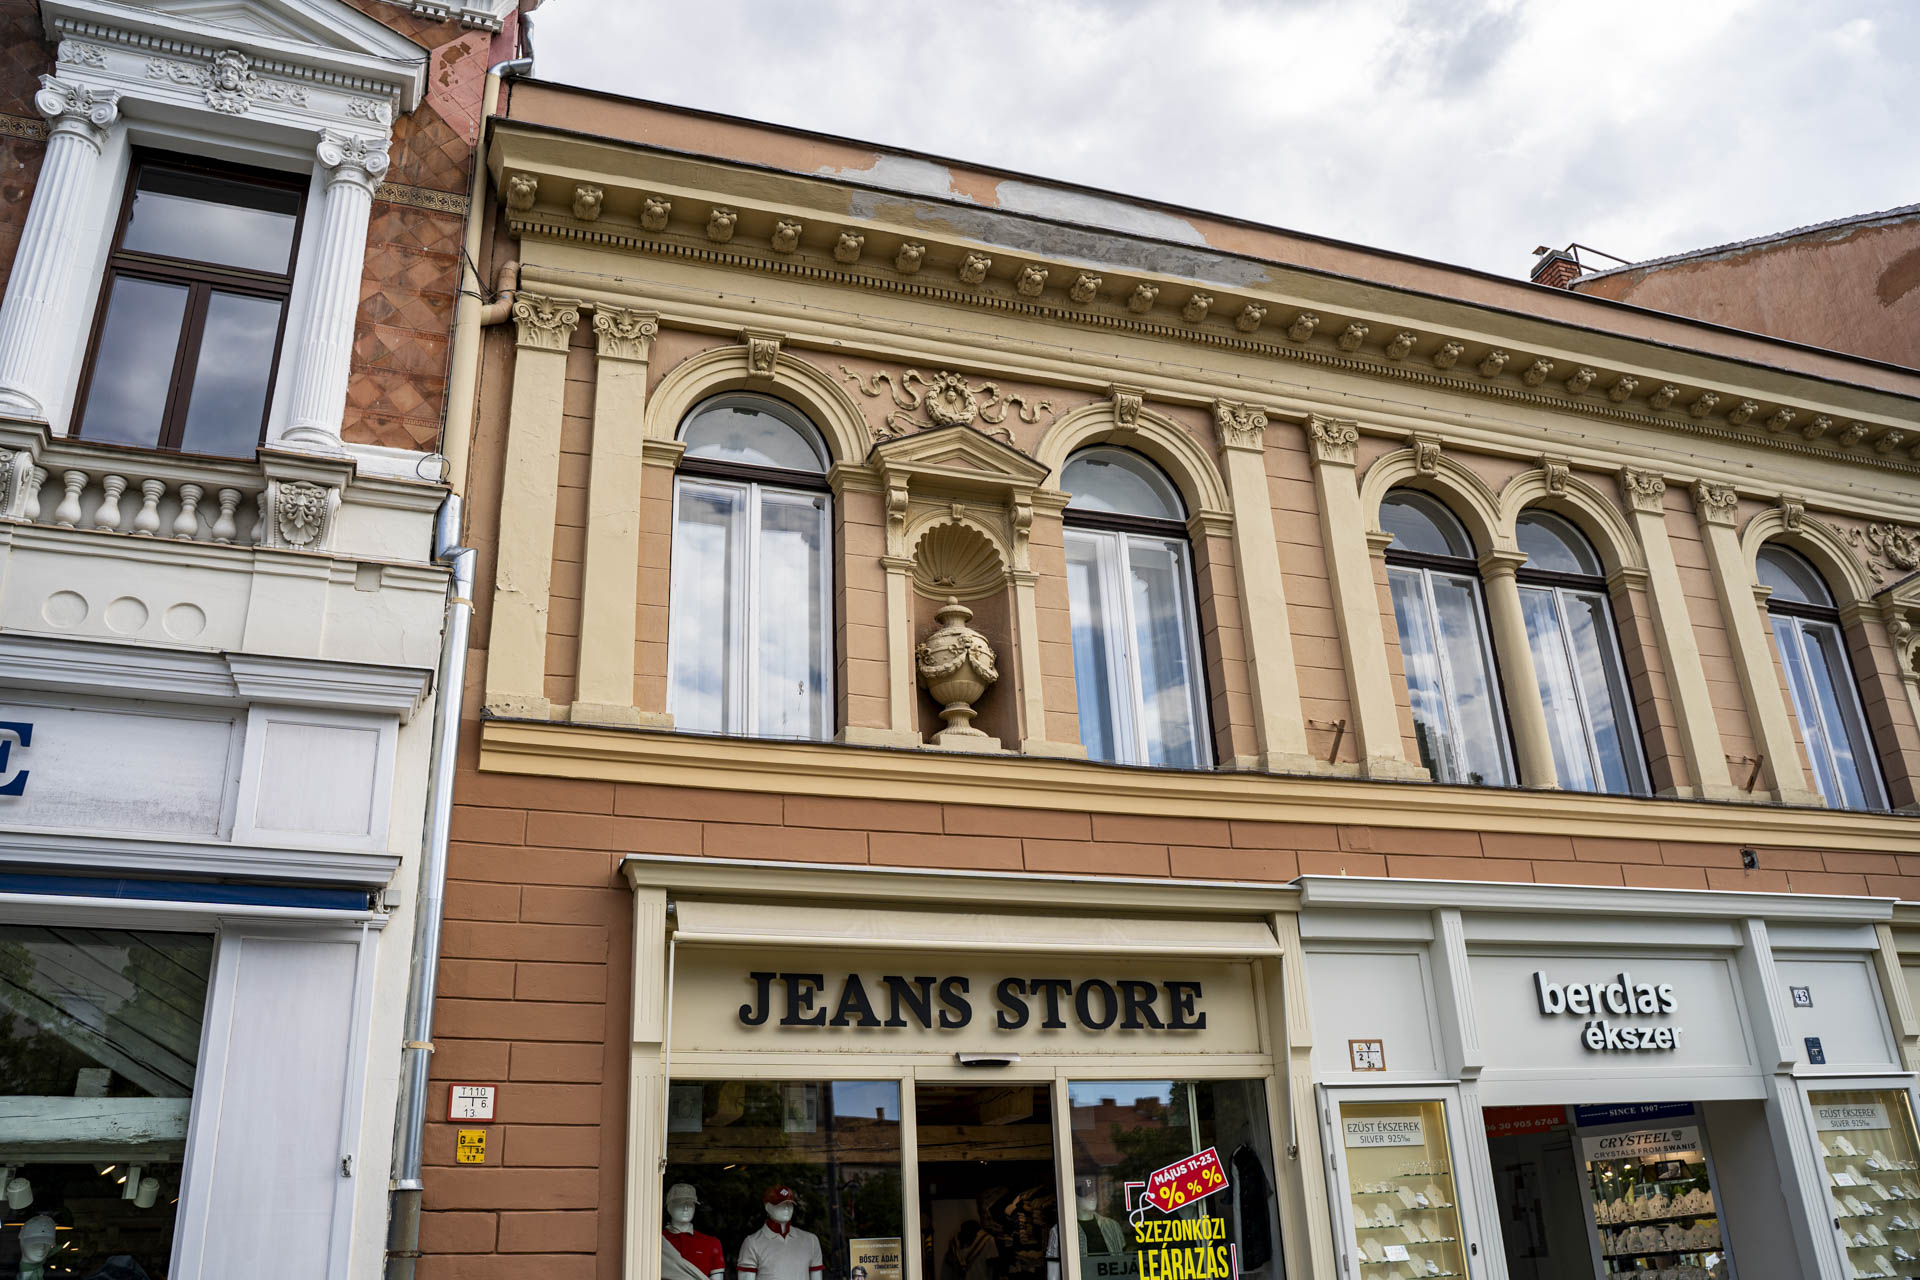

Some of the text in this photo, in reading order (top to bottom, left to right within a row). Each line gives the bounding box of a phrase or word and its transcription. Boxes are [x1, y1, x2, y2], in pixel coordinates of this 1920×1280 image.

[739, 971, 1206, 1029] JEANS STORE
[1795, 990, 1808, 1002] 43
[1581, 1020, 1683, 1050] ékszer
[1609, 1105, 1659, 1117] SINCE 1907
[1820, 1107, 1876, 1118] EZÜST ÉKSZEREK
[1347, 1120, 1420, 1133] EZÜST ÉKSZEREK
[1831, 1120, 1850, 1128] SILVER
[1360, 1135, 1384, 1143] SILVER
[1599, 1132, 1670, 1149] CRYSTEEL
[1594, 1149, 1636, 1159] CRYSTALS
[1638, 1146, 1661, 1154] FROM
[1187, 1153, 1216, 1171] 11-23.
[1134, 1215, 1226, 1243] SZEZONKÖZI
[1137, 1242, 1229, 1280] LEÁRAZÁS
